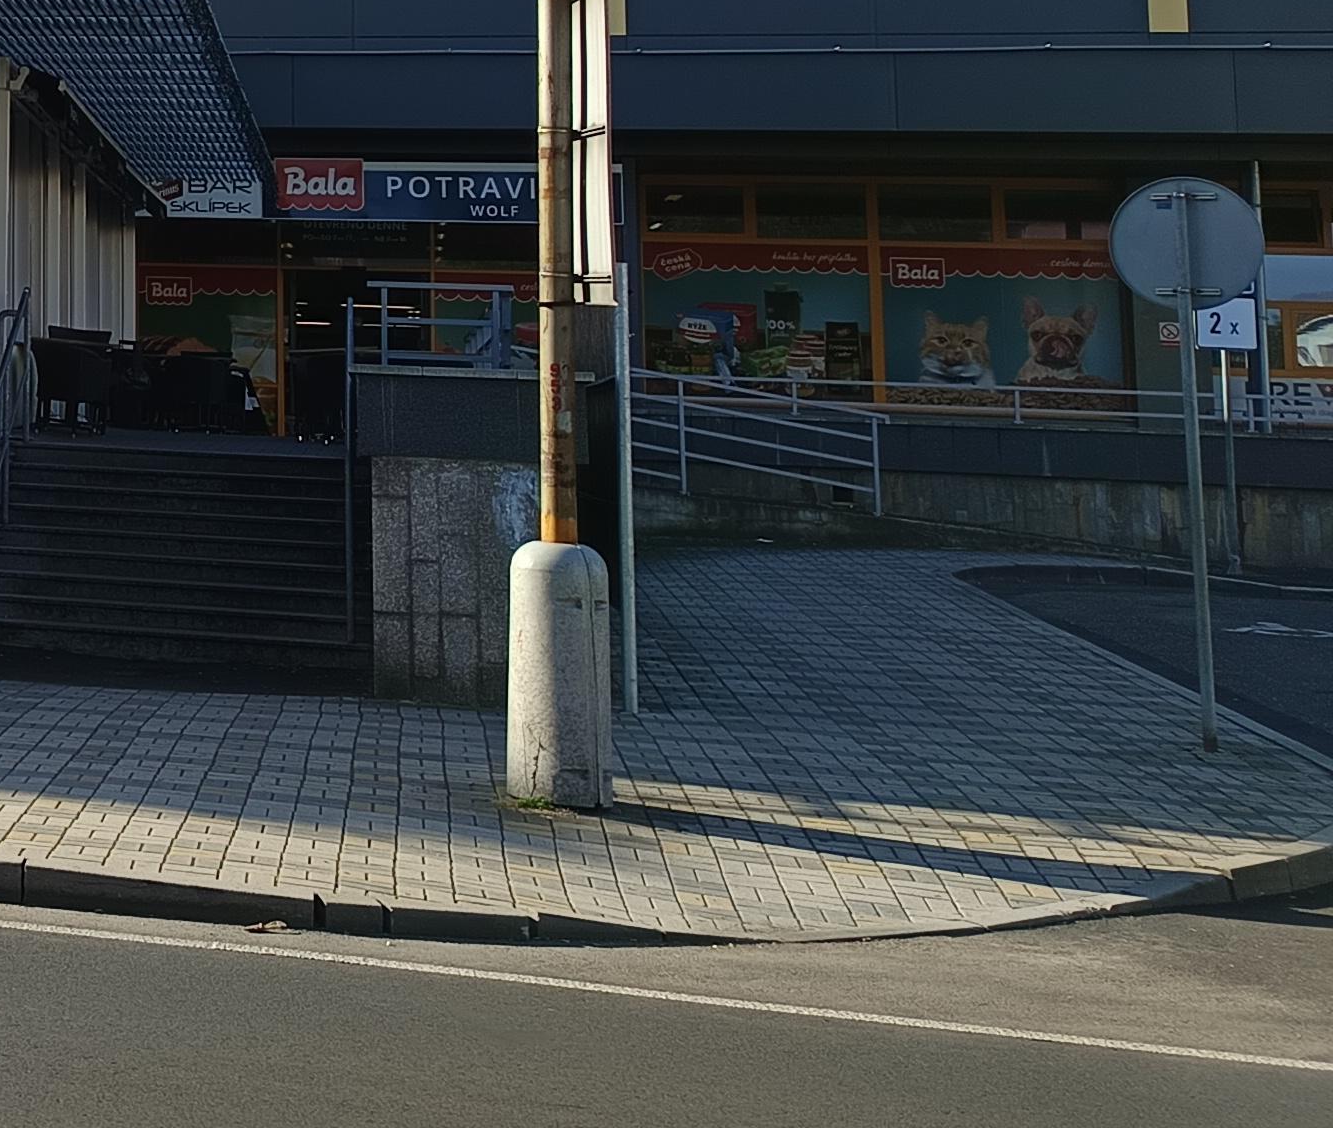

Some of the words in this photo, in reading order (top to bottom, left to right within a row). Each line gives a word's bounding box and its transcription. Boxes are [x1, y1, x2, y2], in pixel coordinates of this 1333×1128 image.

[188, 177, 253, 193] BAR
[284, 167, 356, 196] Bala
[386, 176, 536, 200] POTRAVI
[170, 198, 252, 214] SKLÍPEK
[470, 204, 520, 217] WOLF
[896, 263, 940, 281] Bala
[151, 282, 188, 298] Bala
[1210, 312, 1222, 334] 2
[1230, 322, 1239, 335] x
